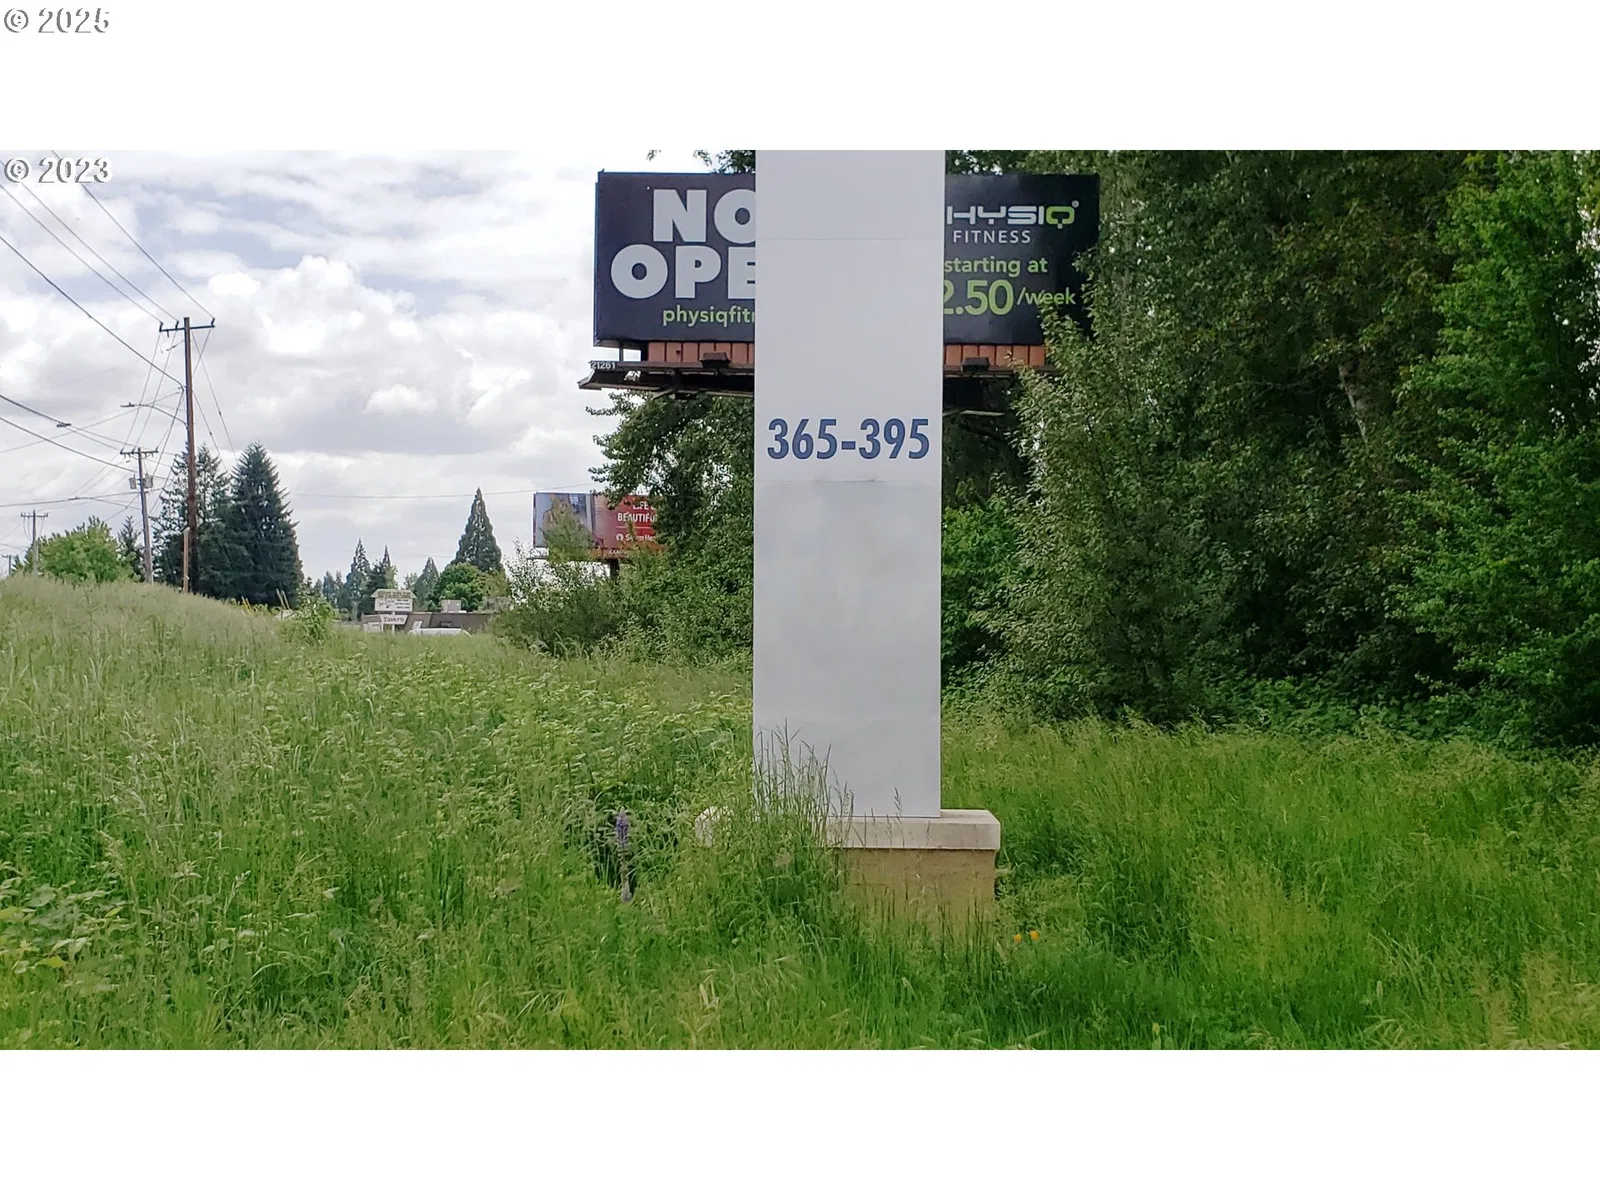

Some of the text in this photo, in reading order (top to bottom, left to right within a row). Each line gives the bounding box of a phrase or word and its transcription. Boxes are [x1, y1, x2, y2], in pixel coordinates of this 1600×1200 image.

[953, 230, 1031, 243] FITNESS
[610, 244, 756, 300] OPE
[944, 256, 1048, 277] starting at
[591, 361, 615, 370] 21261
[767, 418, 930, 460] 365-395
